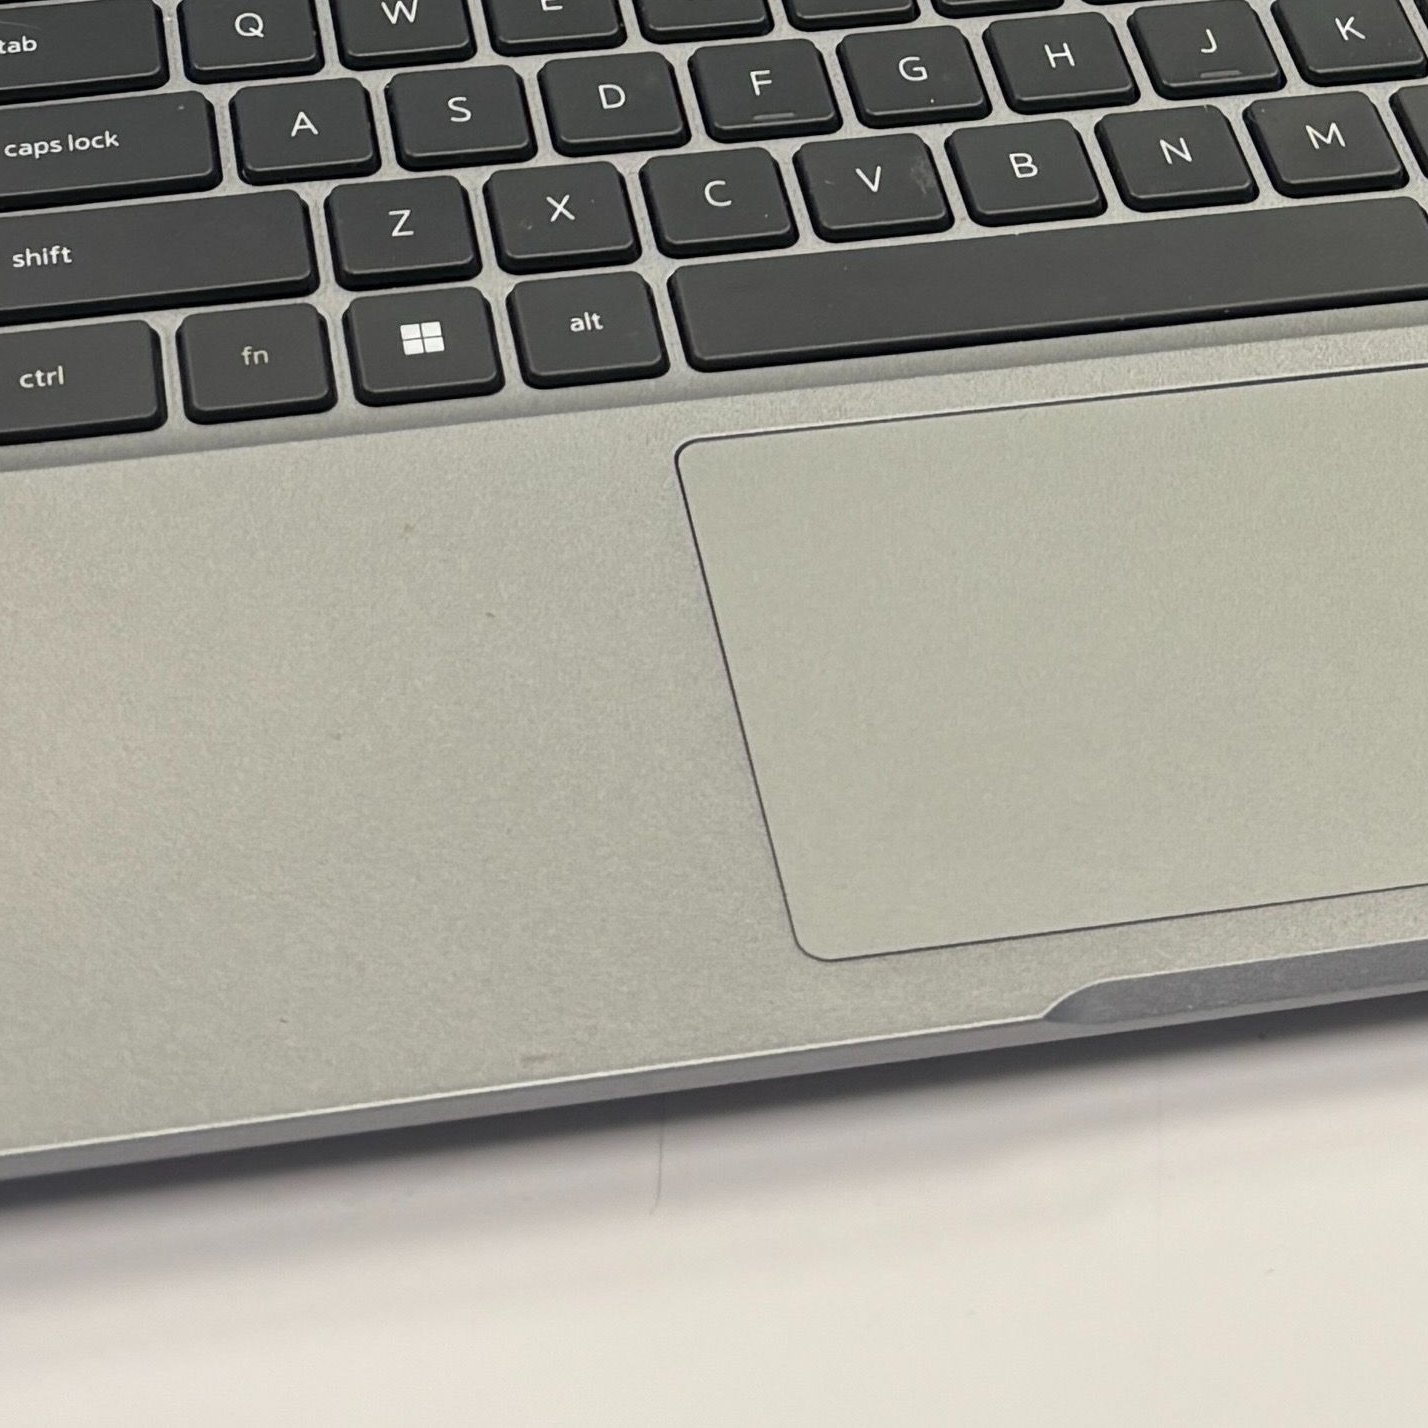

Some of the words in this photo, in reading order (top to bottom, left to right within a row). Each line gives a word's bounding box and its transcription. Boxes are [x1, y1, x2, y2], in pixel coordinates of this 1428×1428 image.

[382, 0, 417, 24] W
[235, 13, 264, 37] Q
[5, 140, 62, 158] caps
[68, 131, 119, 151] lock
[13, 246, 72, 267] shift
[571, 312, 603, 331] alt
[242, 346, 268, 365] fn
[20, 366, 63, 388] ctrl
